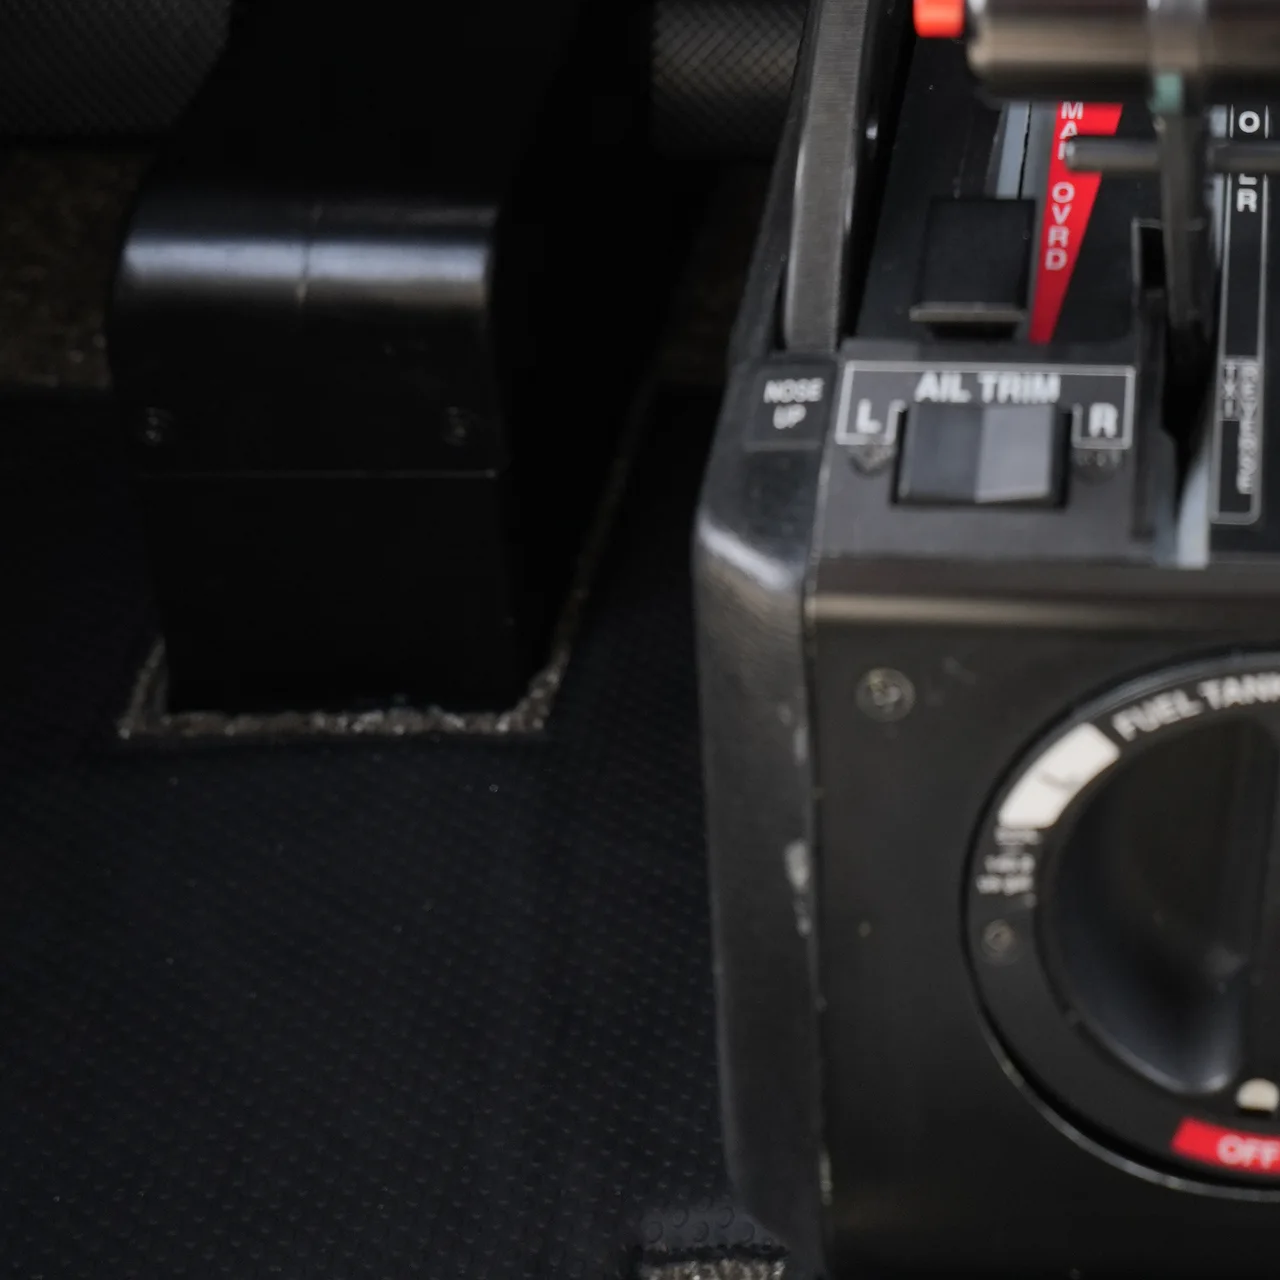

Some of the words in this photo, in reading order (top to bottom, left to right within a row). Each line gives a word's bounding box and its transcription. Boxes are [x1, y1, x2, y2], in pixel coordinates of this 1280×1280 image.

[915, 372, 971, 402] AIL
[978, 372, 1061, 404] TRIM
[1112, 696, 1197, 739] FUEL
